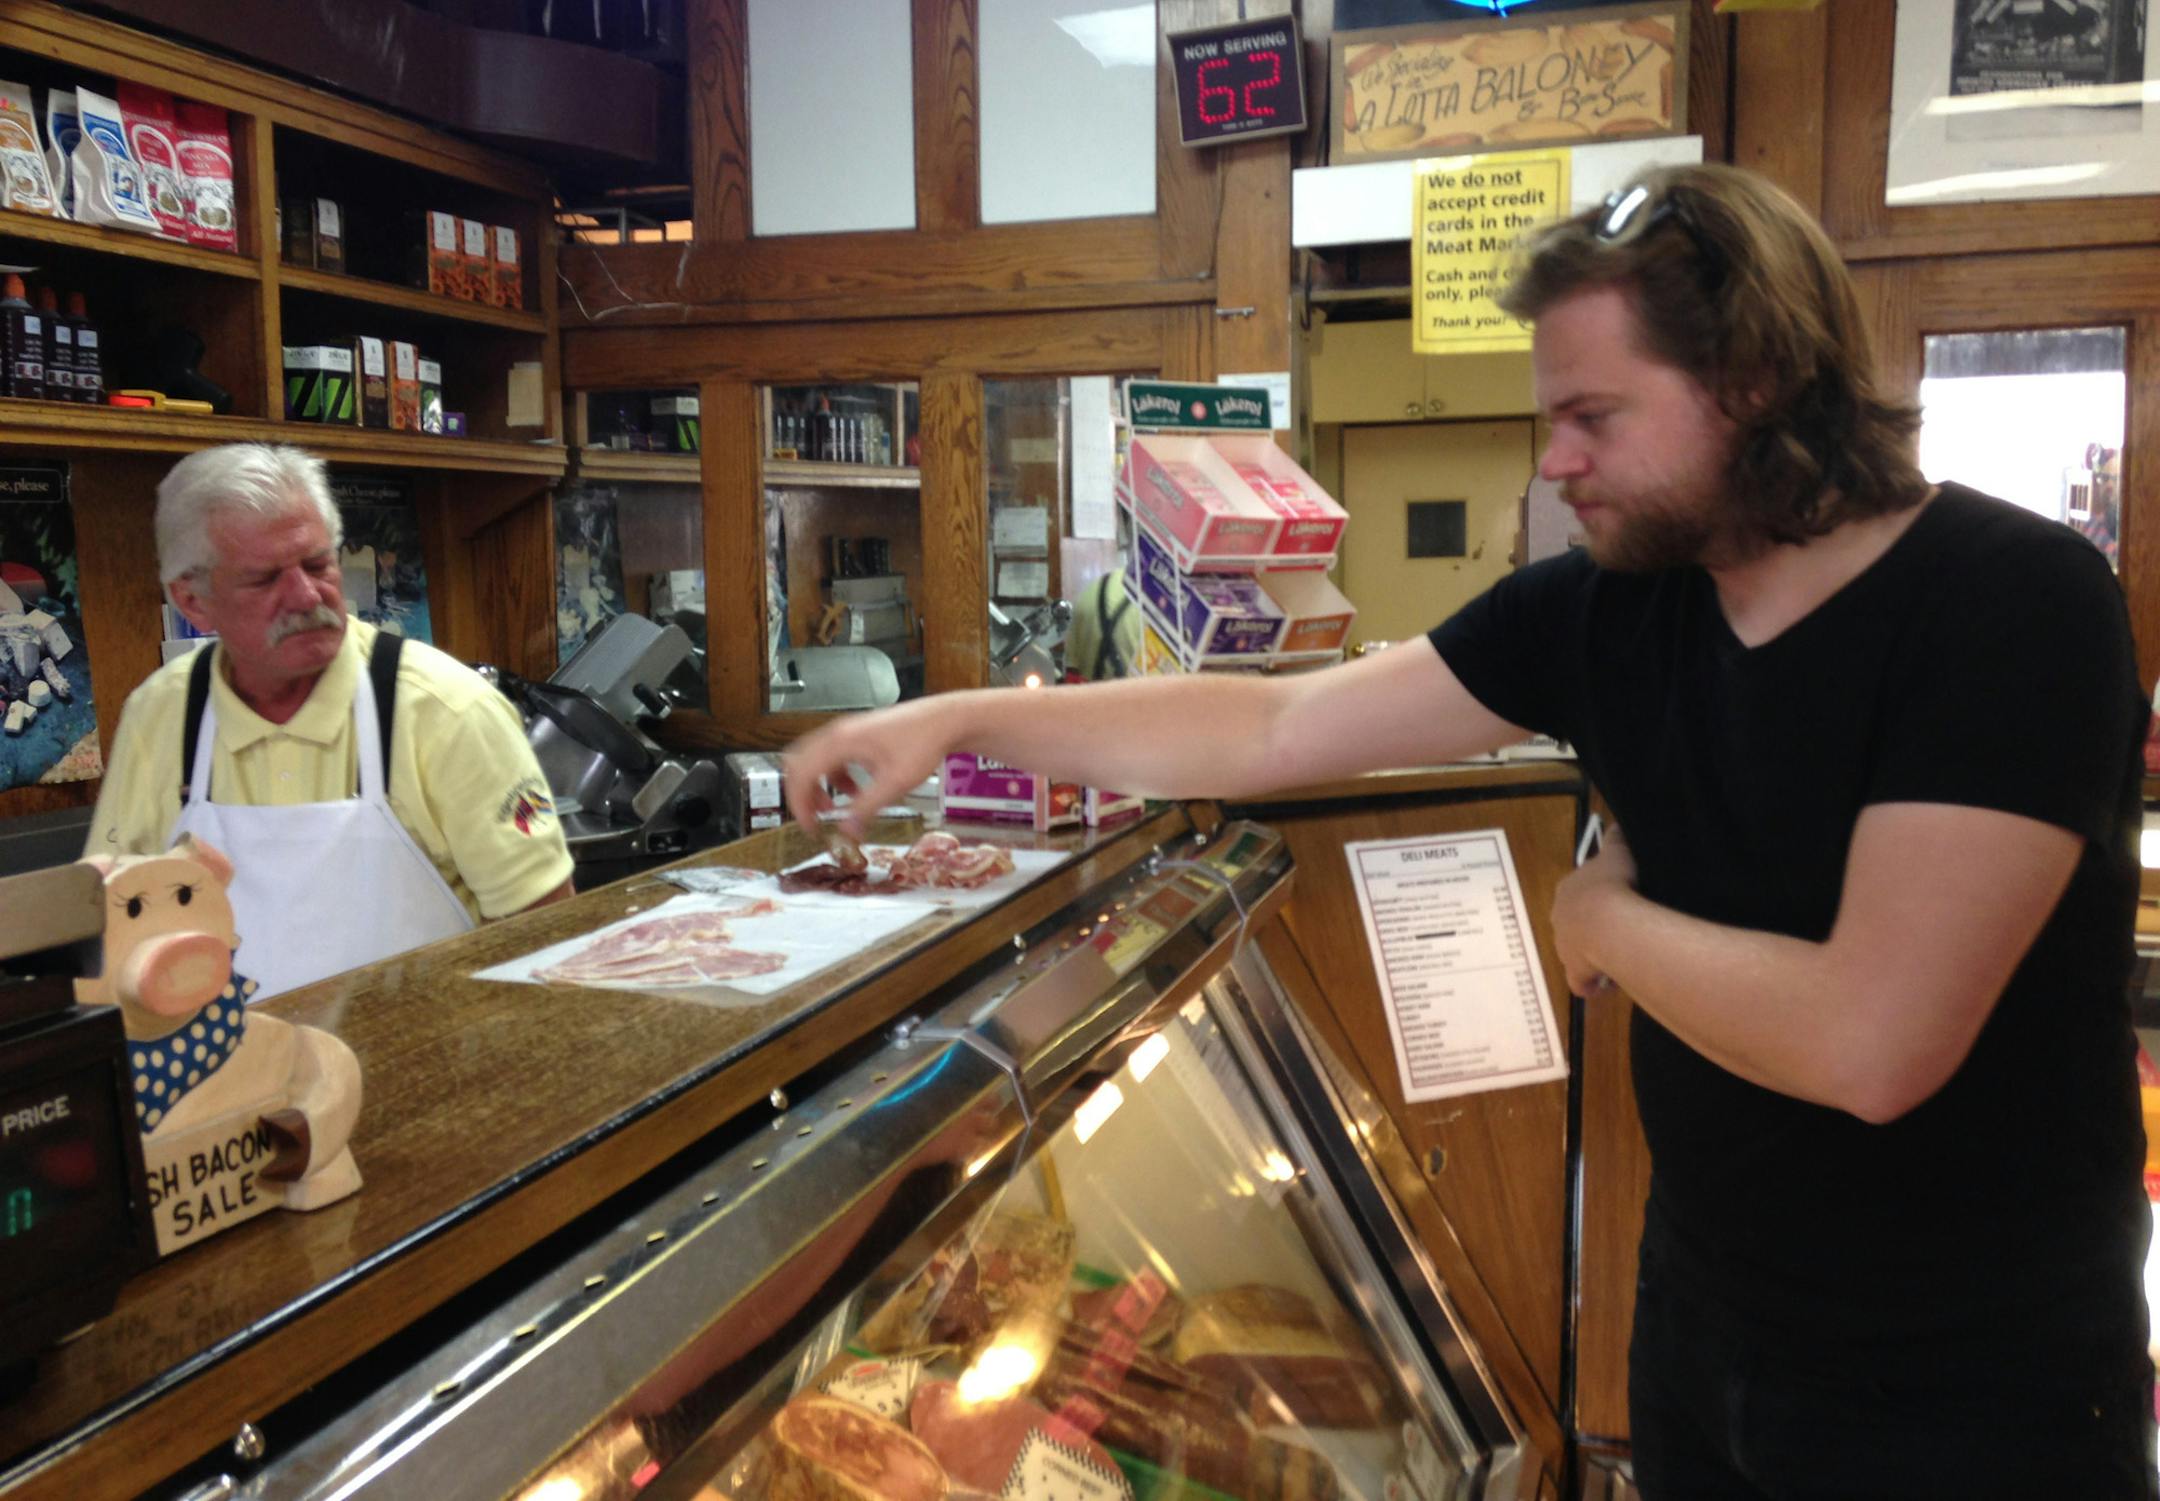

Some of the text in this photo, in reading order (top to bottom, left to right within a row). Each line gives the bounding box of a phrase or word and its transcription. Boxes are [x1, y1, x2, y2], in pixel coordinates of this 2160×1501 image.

[1184, 31, 1287, 60] NOW SERVING
[1197, 50, 1281, 124] 62
[1470, 43, 1655, 115] BALONEY
[1428, 170, 1522, 189] We do not
[1427, 189, 1545, 212] accept credit
[1427, 212, 1535, 233] cards in the
[1427, 240, 1473, 255] Meat
[1426, 269, 1463, 283] Cash
[1468, 267, 1498, 280] and
[1426, 287, 1464, 301] only,
[1432, 315, 1471, 328] Thank
[14, 477, 49, 494] please
[1401, 847, 1459, 863] DELI MEATS
[1, 1096, 71, 1136] PRICE
[189, 1127, 274, 1187] BACON
[172, 1172, 258, 1236] SALE
